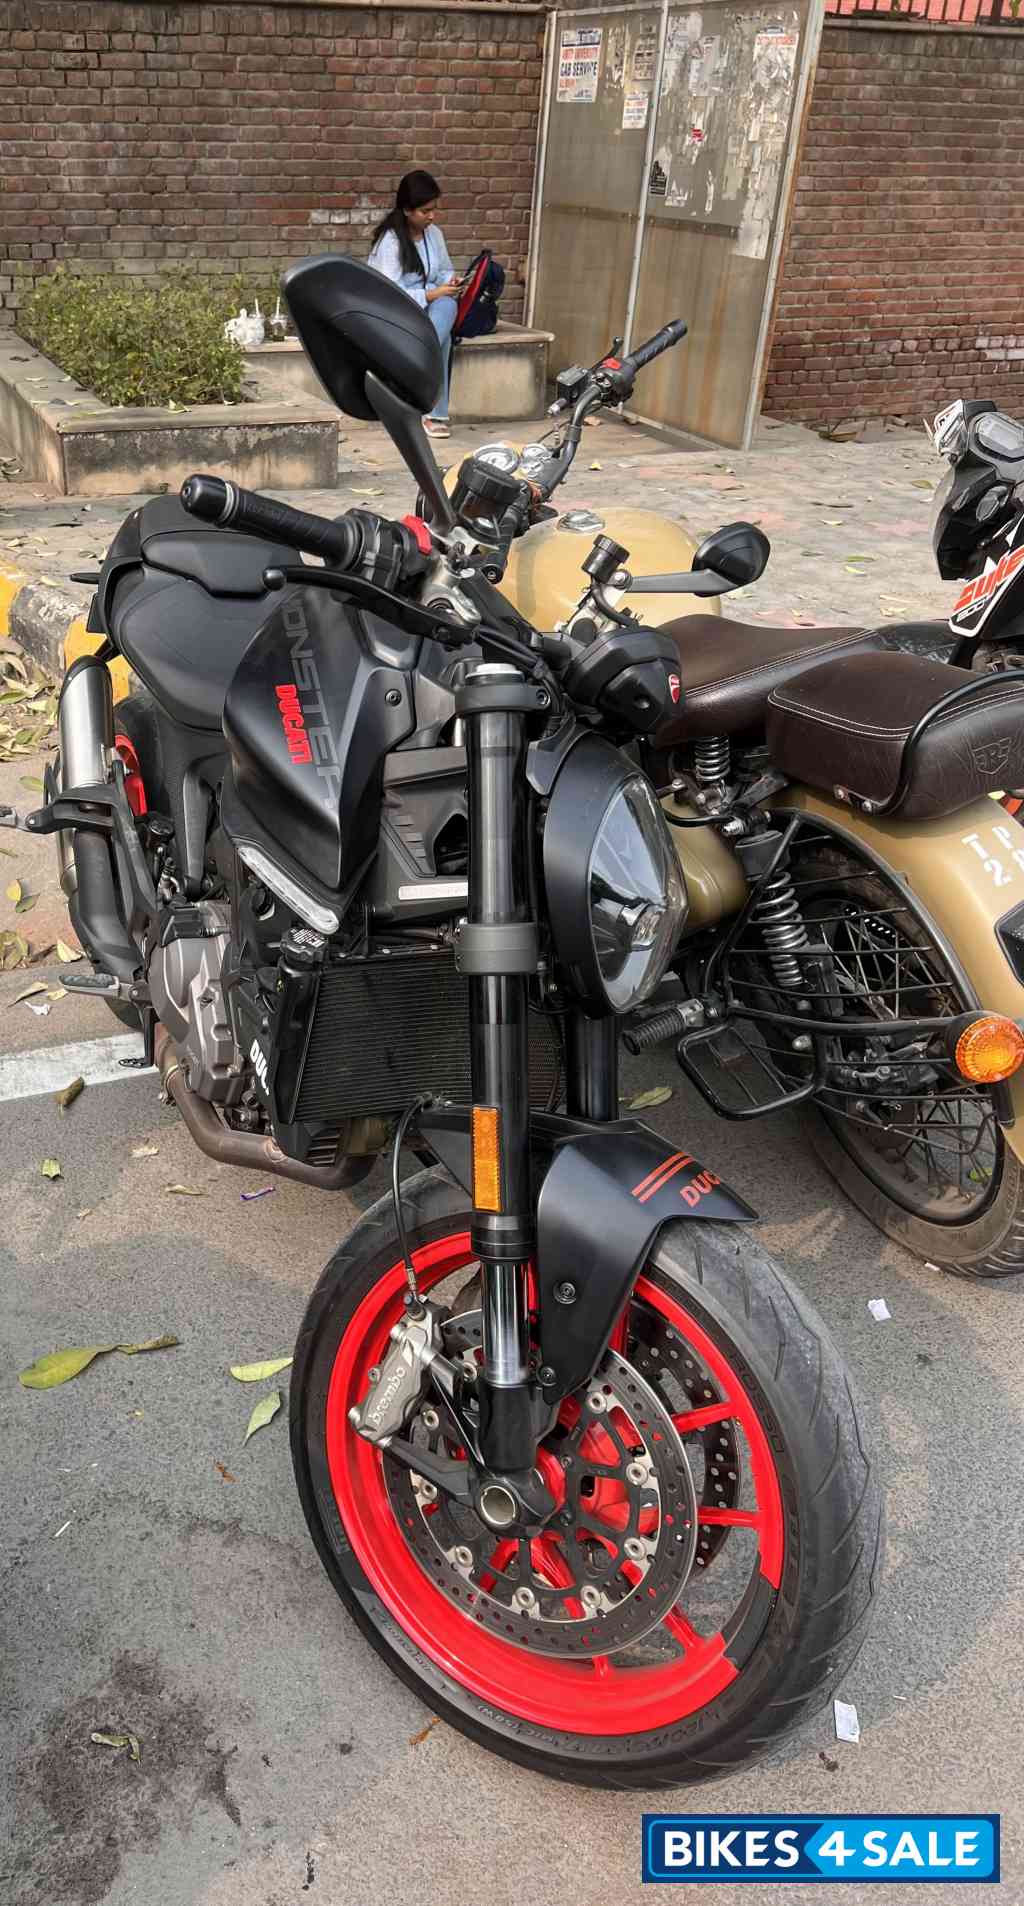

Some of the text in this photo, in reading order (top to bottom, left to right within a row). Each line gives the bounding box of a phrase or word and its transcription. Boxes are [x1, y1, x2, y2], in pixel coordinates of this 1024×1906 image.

[560, 62, 572, 77] CAB
[274, 683, 313, 765] DUCATI
[961, 833, 989, 859] T
[368, 1366, 406, 1426] brembo
